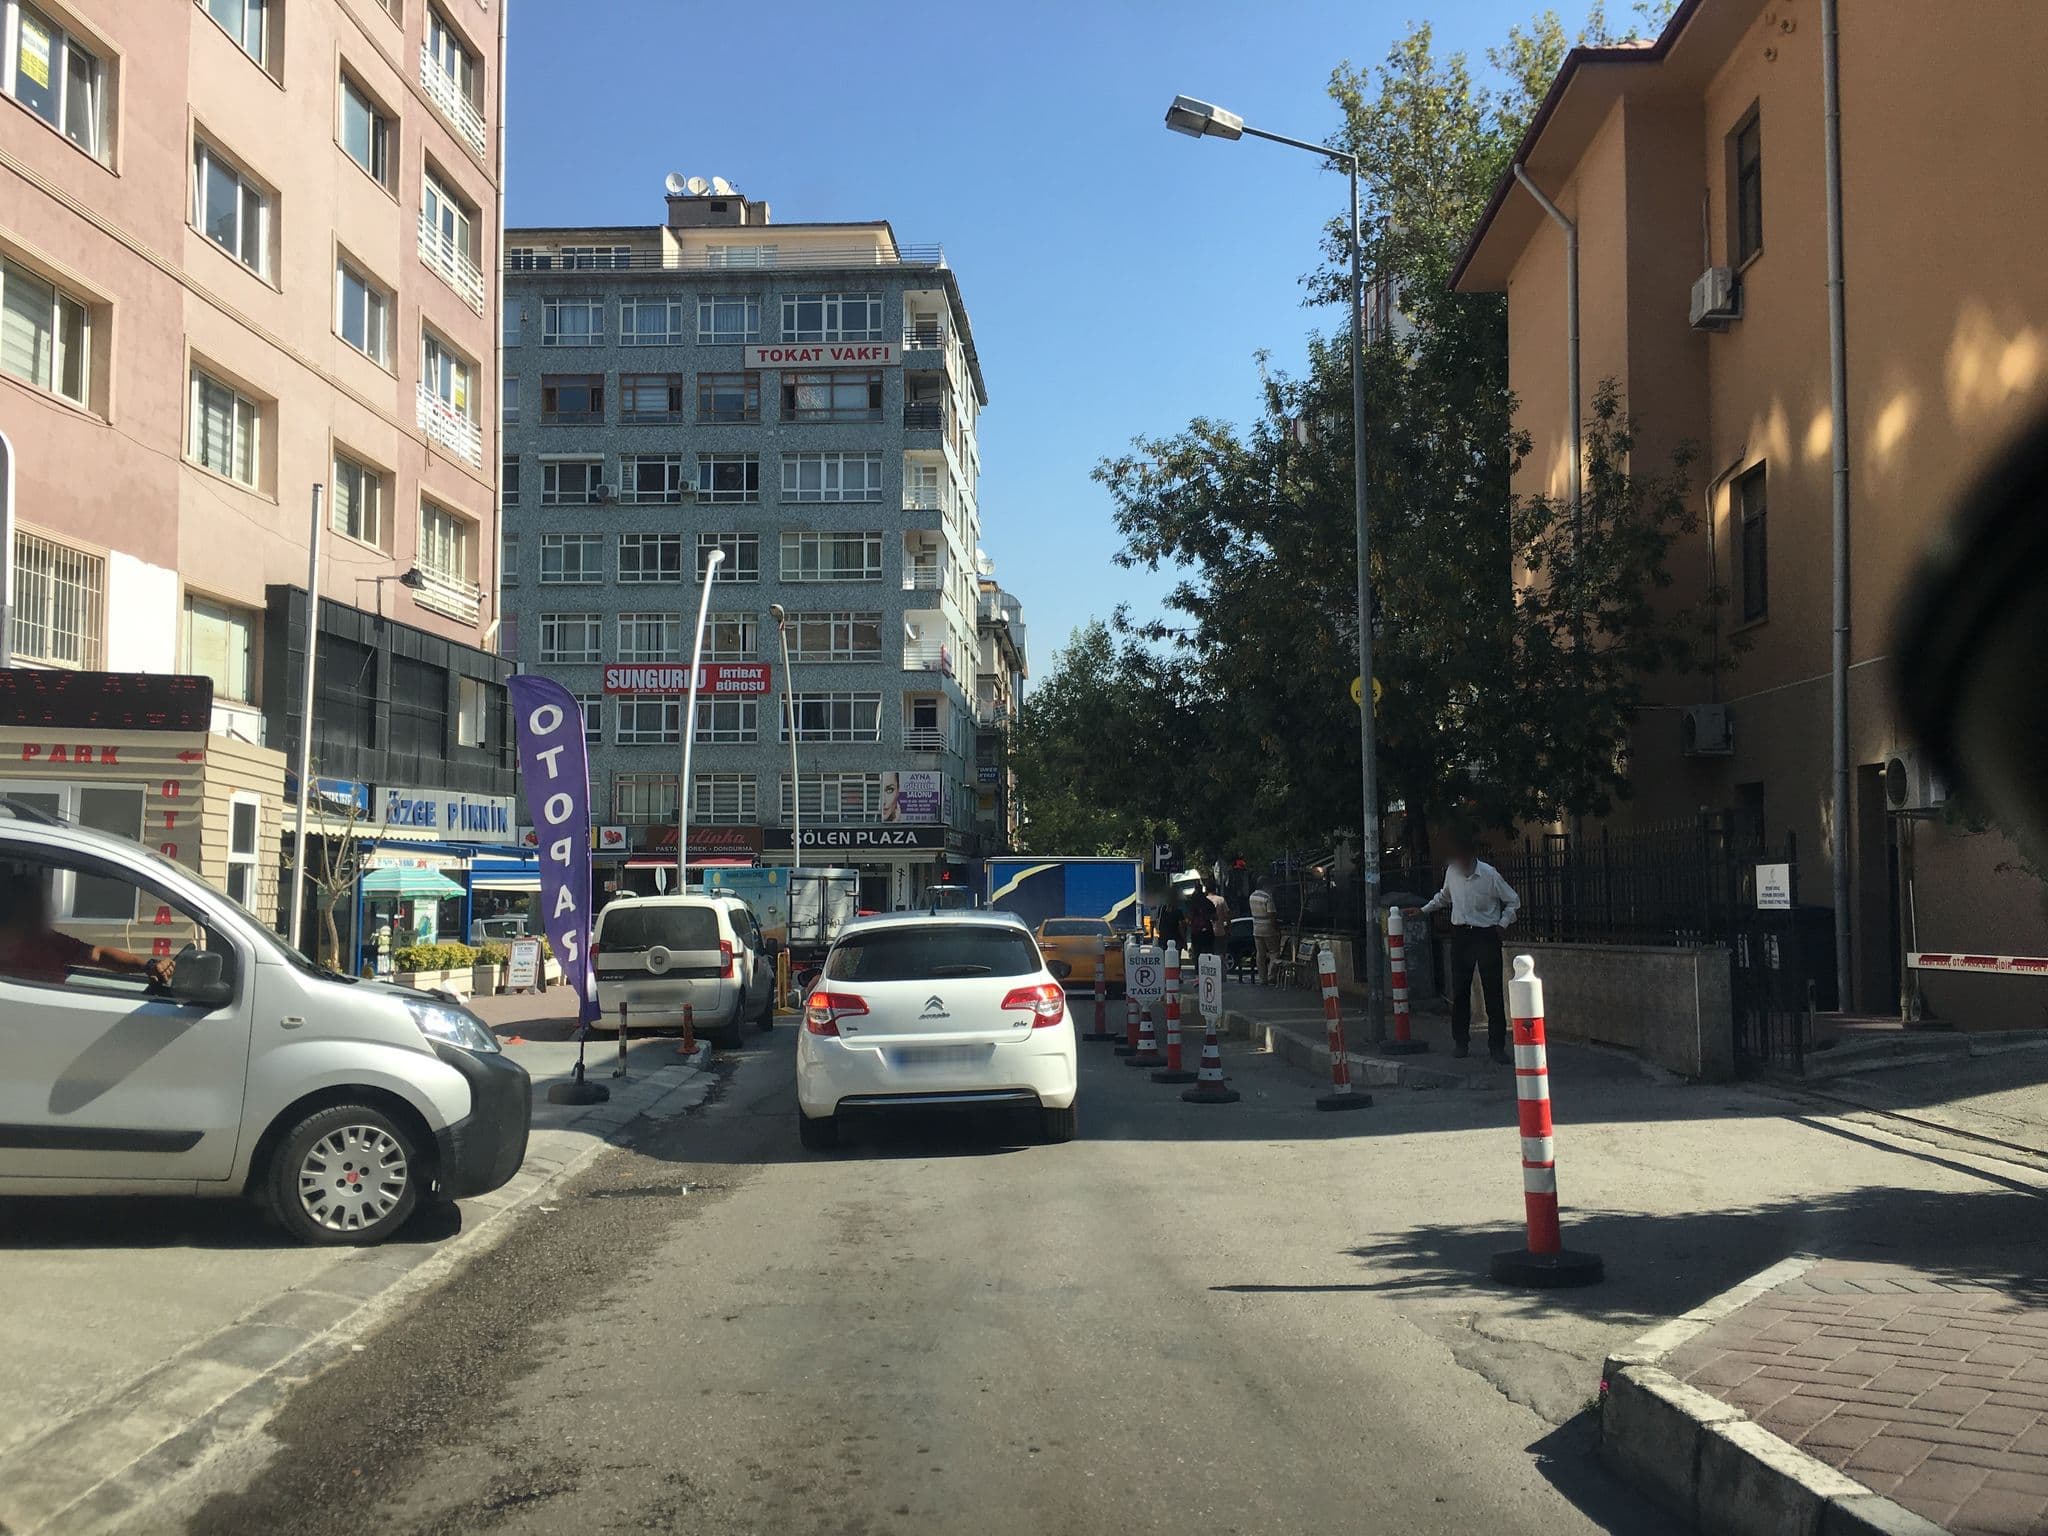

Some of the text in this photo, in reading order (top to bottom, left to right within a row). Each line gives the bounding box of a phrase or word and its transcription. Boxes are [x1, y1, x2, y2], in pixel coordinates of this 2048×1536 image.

[757, 347, 889, 362] TOKAT VAKFI
[719, 667, 763, 679] İRTİBAT
[716, 680, 765, 692] BÜROSU
[22, 743, 120, 765] PARK
[387, 790, 437, 827] ÖZGE
[447, 797, 509, 833] PİKNİK
[856, 831, 918, 845] PLAZA
[1129, 956, 1161, 966] SÜMER
[1130, 987, 1162, 995] TAKSİ
